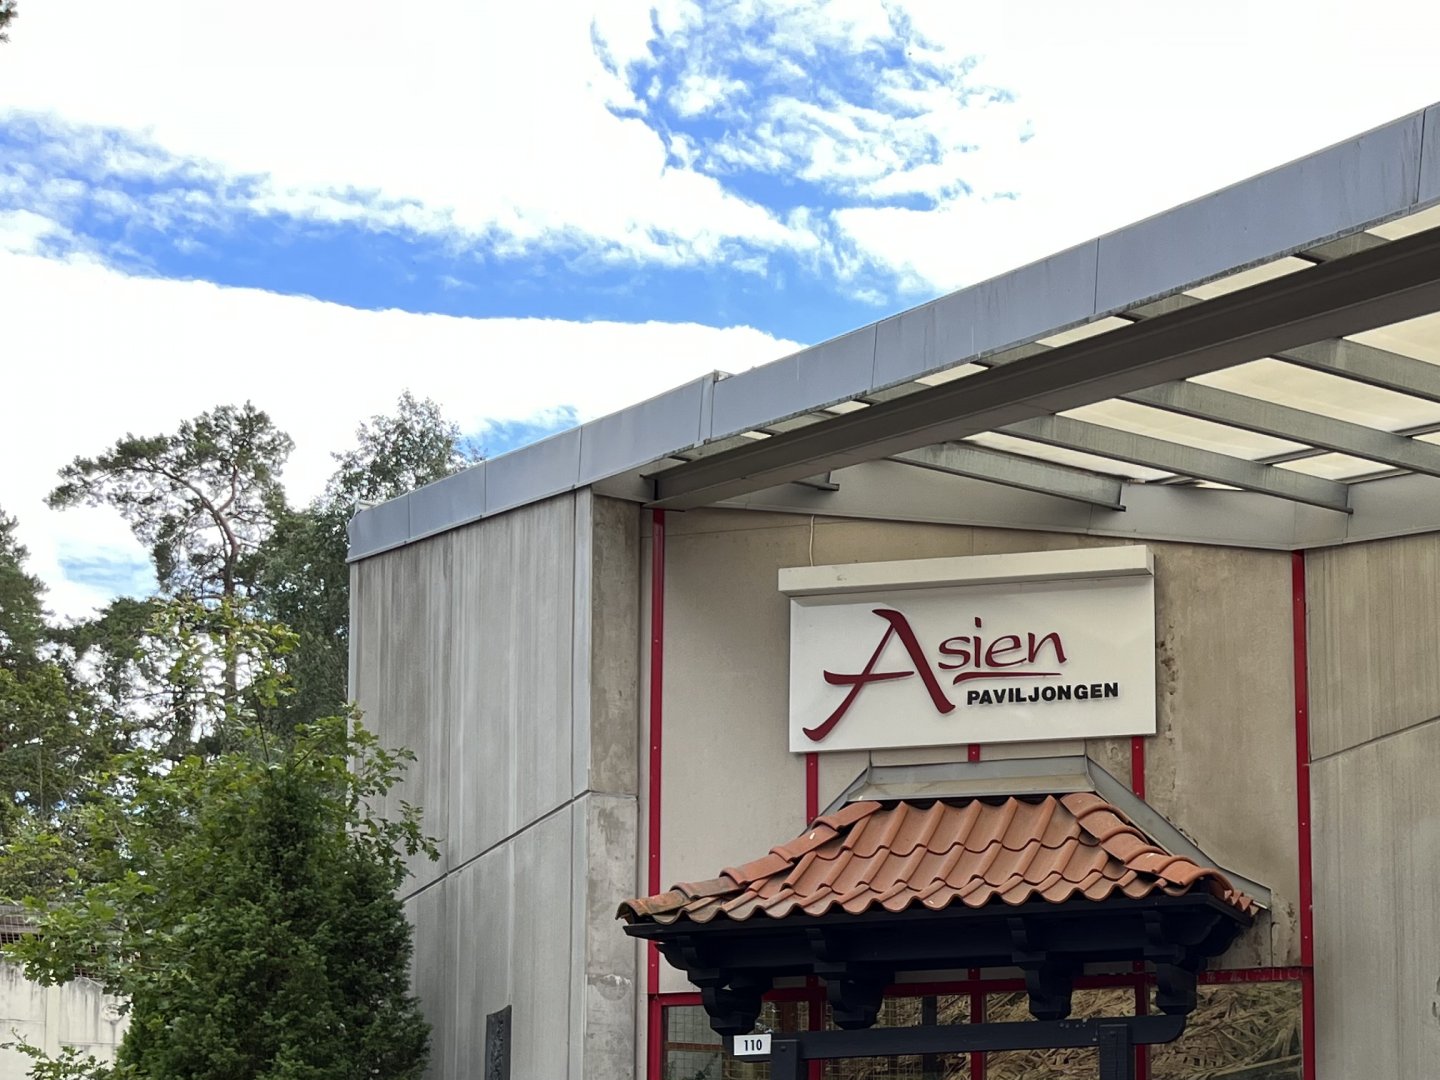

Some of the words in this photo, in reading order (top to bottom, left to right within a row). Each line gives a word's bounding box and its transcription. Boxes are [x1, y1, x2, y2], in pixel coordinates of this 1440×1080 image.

[802, 609, 1067, 742] Asien
[966, 682, 1119, 706] PAVILJONGEN
[744, 1039, 763, 1052] 110
